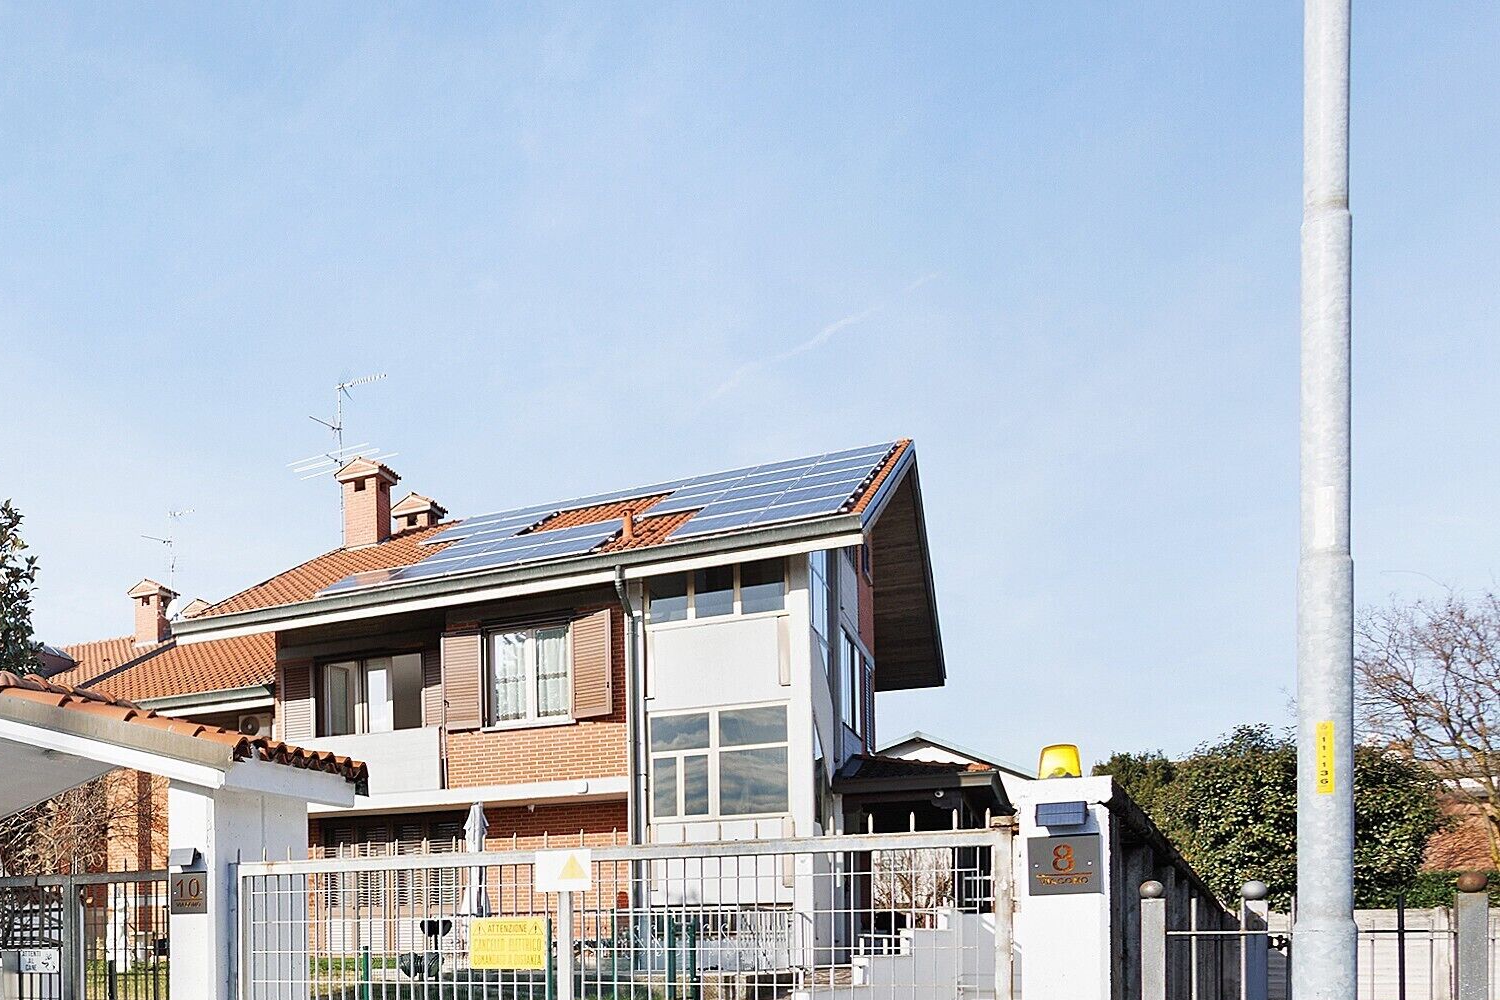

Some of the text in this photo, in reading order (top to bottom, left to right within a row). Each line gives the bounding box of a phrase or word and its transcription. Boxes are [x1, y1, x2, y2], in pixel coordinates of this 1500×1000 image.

[1052, 843, 1076, 872] 8
[176, 878, 200, 898] 10
[487, 923, 528, 933] ATTENZIONE
